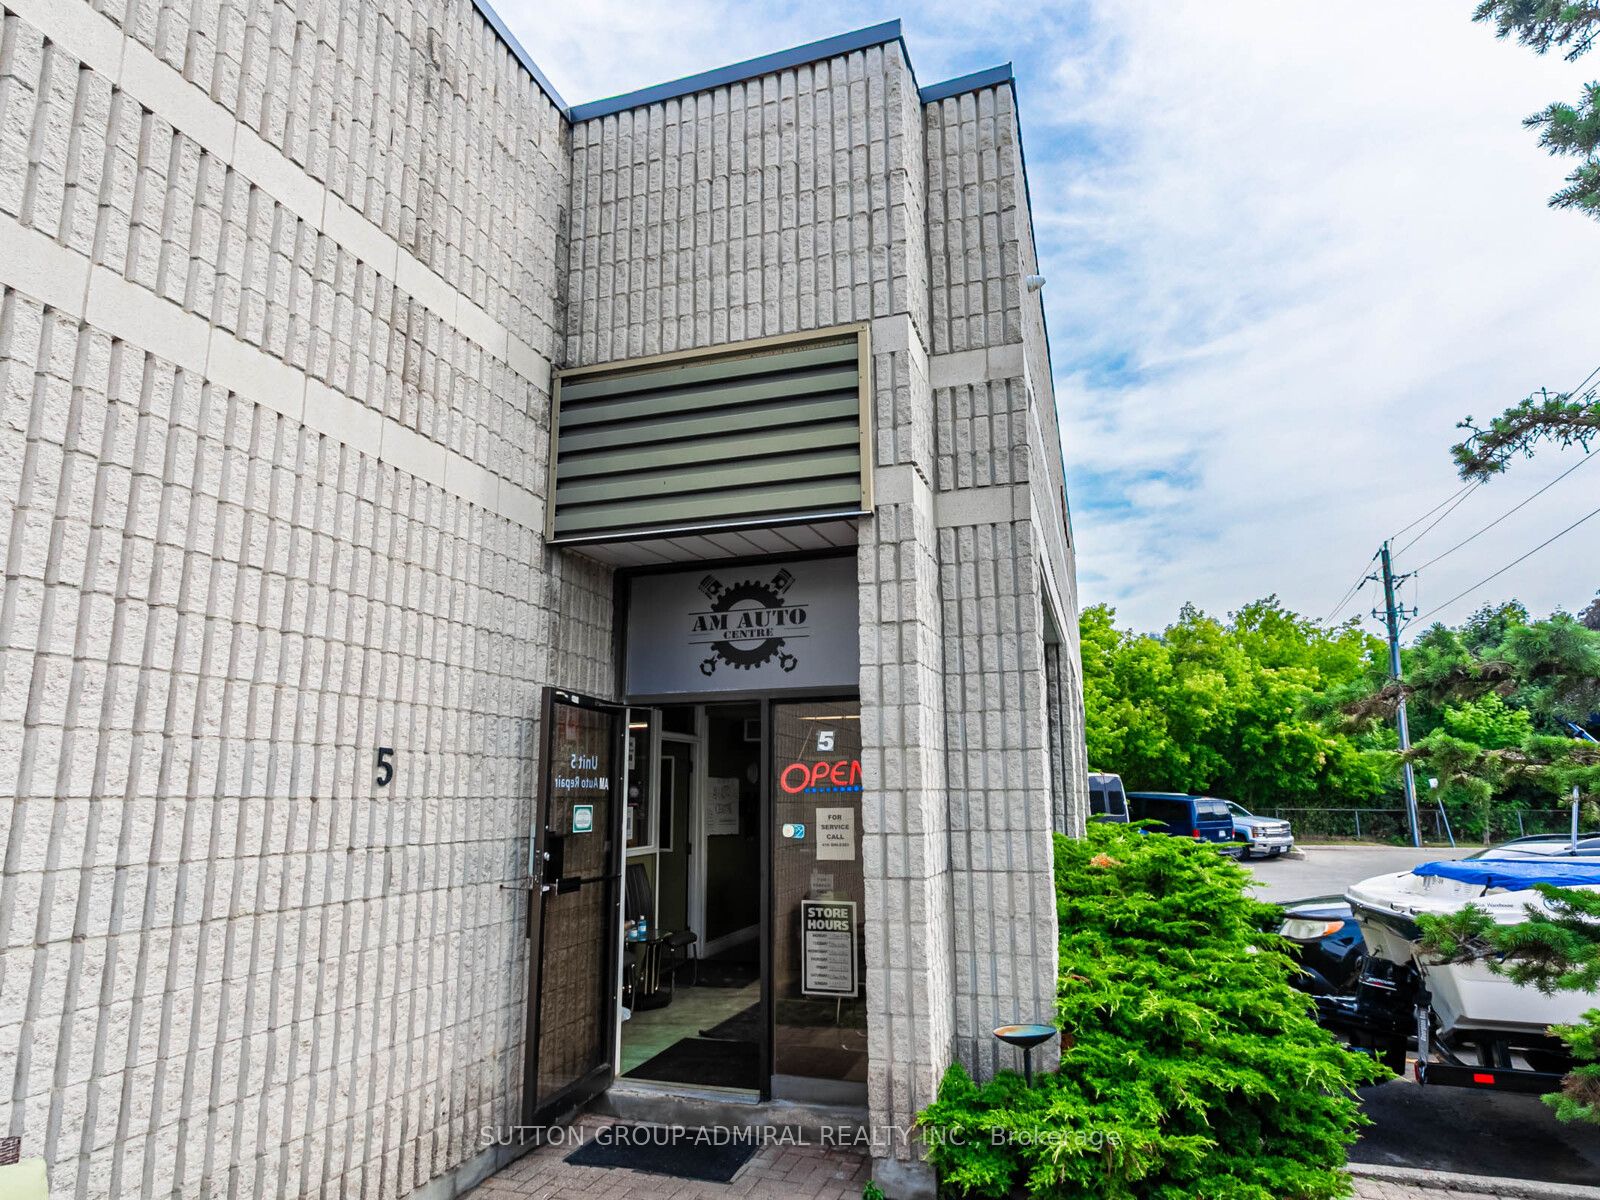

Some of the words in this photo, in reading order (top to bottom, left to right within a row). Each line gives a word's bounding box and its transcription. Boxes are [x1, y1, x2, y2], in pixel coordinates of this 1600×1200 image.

[692, 614, 729, 632] AM
[737, 608, 807, 629] AUTO
[723, 628, 774, 640] CENTRE
[819, 731, 835, 751] 5
[376, 747, 394, 787] 5
[807, 907, 849, 919] STORE
[807, 919, 850, 931] HOURS
